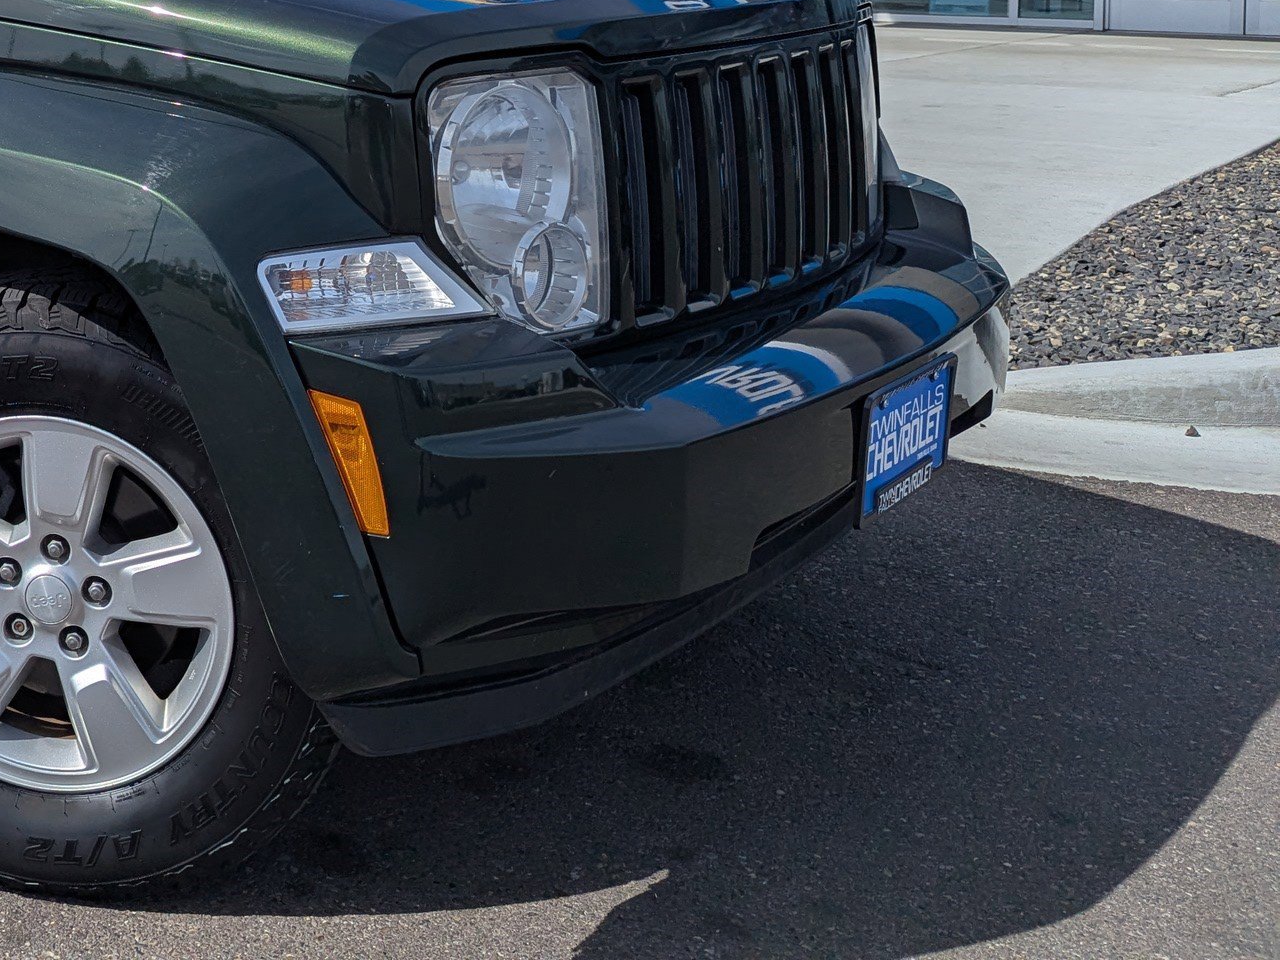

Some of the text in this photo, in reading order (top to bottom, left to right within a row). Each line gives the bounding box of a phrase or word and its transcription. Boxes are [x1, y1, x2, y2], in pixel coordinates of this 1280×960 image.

[866, 404, 943, 482] CHEVROLET
[895, 461, 934, 503] CHEVROLET
[23, 829, 142, 868] A/T2
